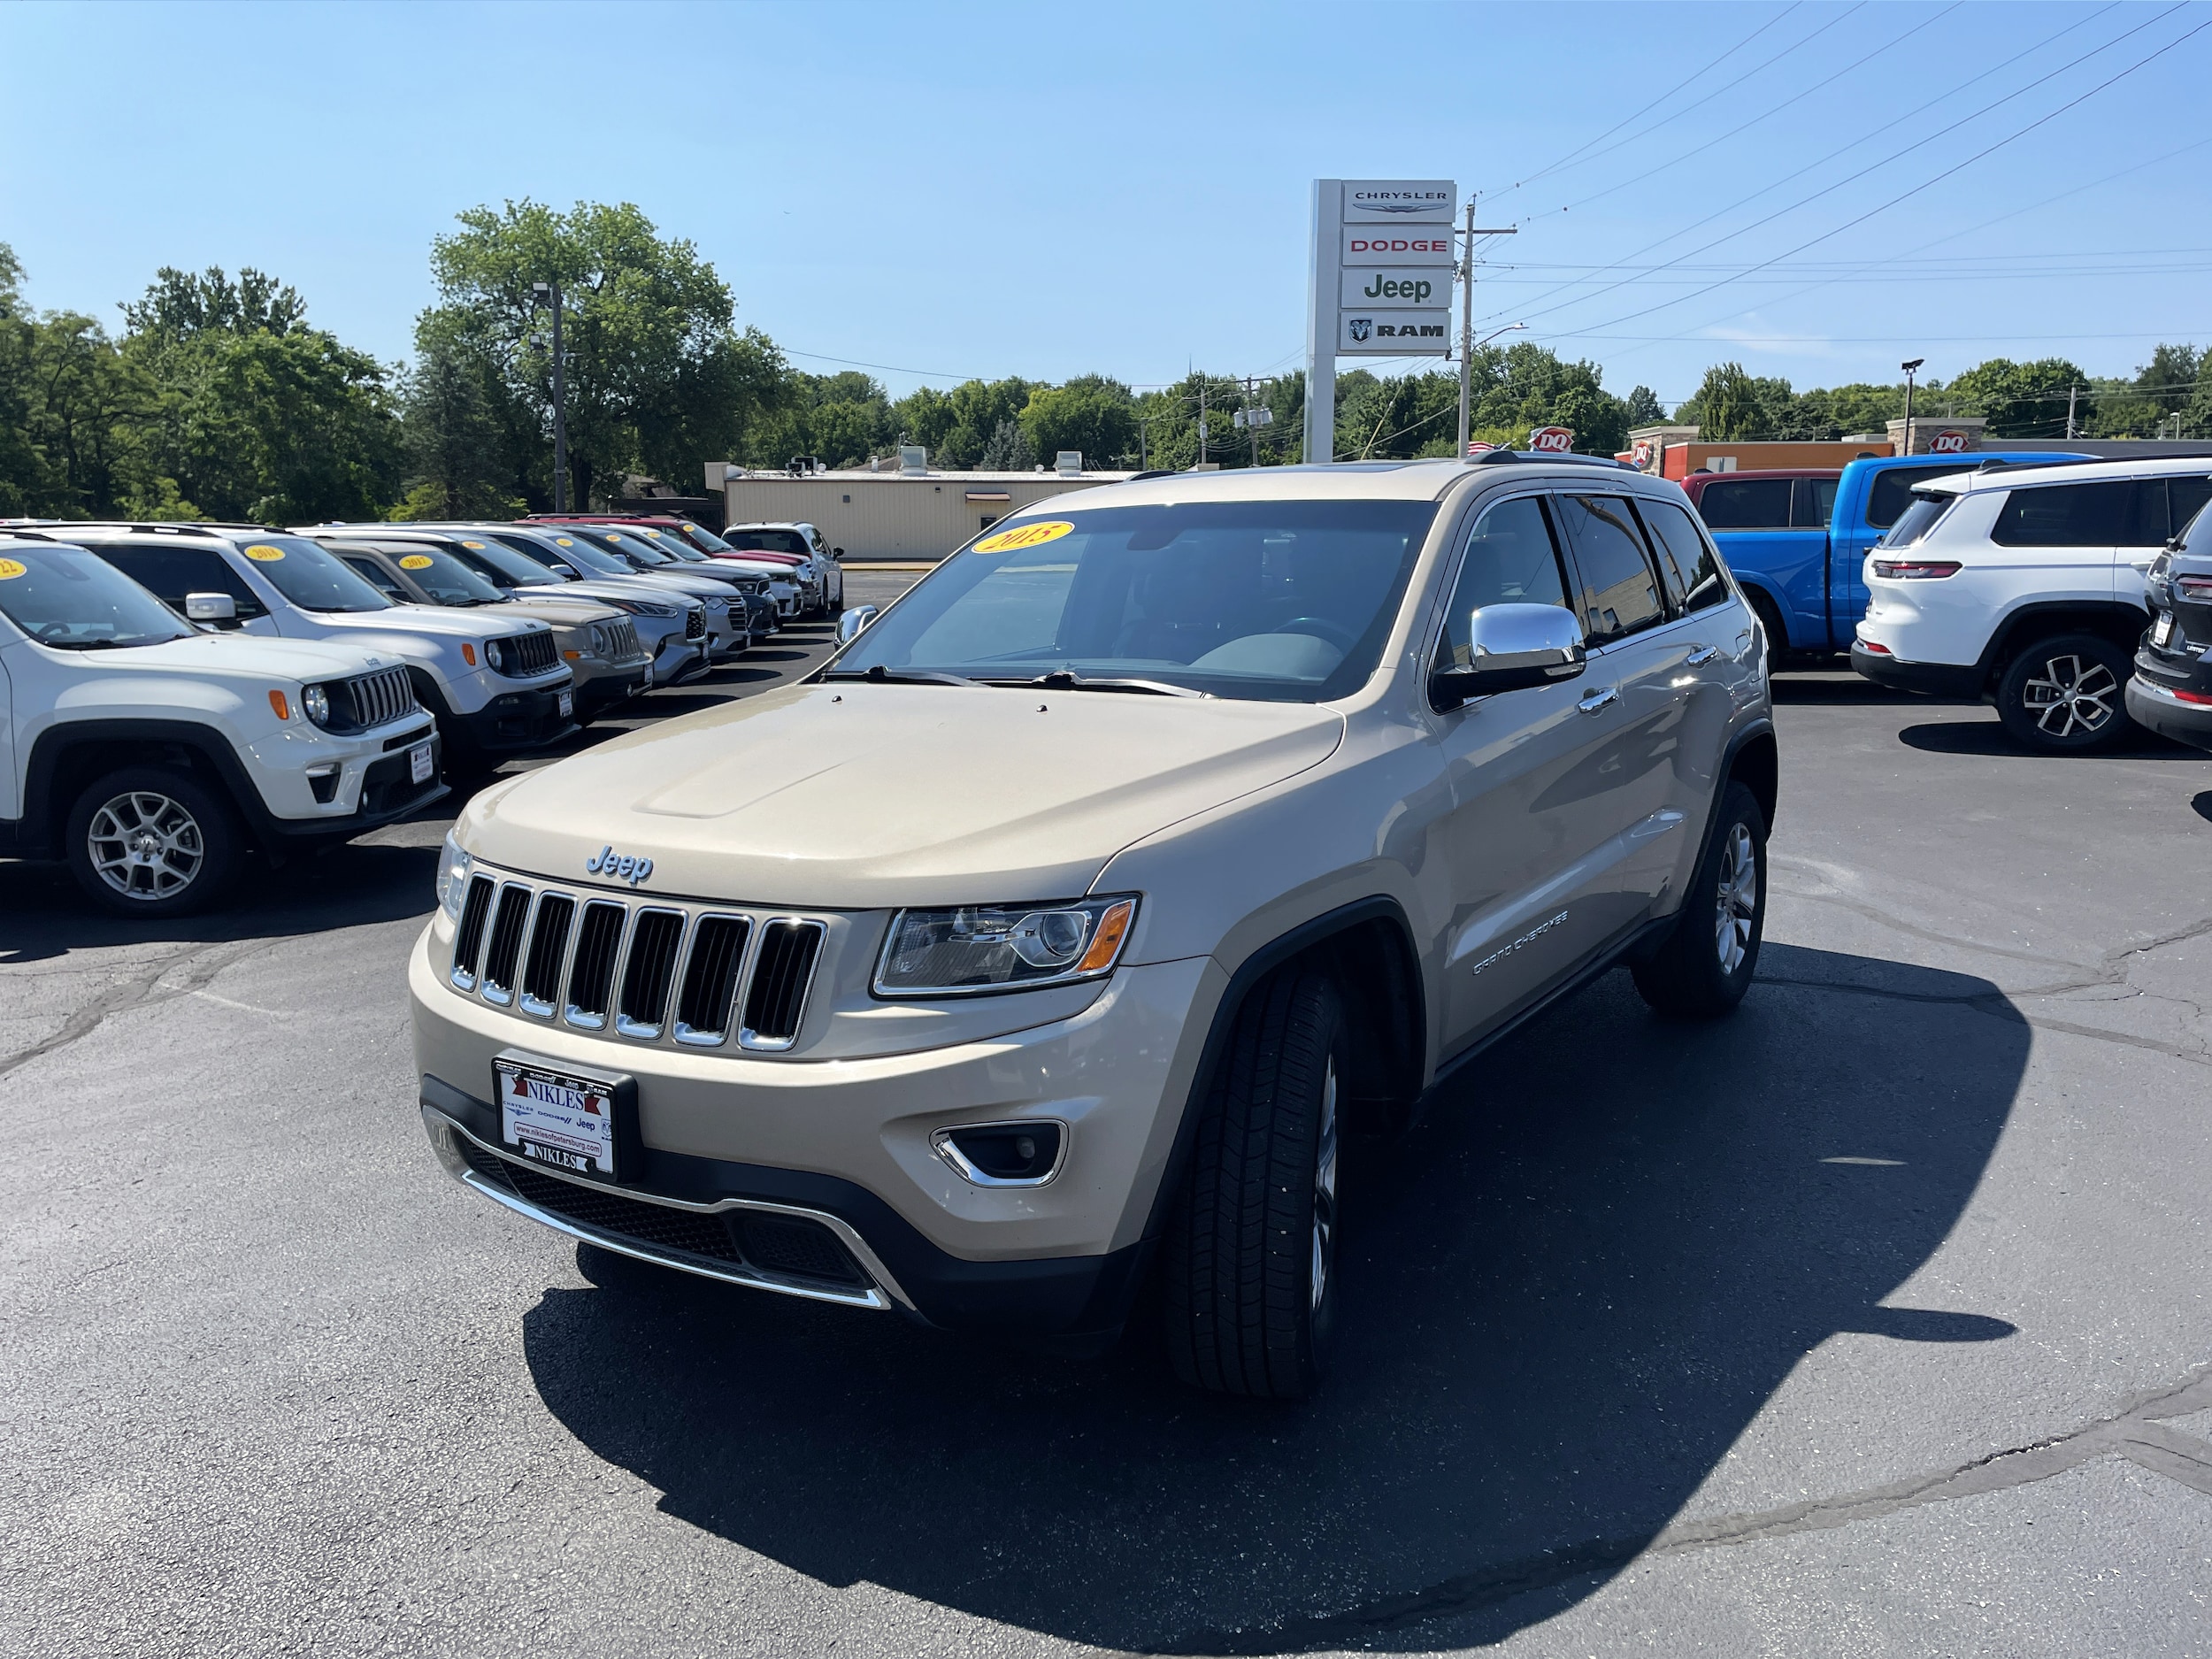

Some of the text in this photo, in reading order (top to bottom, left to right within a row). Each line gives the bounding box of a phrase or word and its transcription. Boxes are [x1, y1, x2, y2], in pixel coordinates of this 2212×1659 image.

[1351, 240, 1448, 252] DODGE
[1364, 273, 1432, 303] Jeep
[1377, 325, 1444, 337] RAM
[1538, 434, 1567, 449] DQ
[1636, 446, 1647, 461] DQ
[1936, 436, 1964, 452] DQ
[982, 525, 1062, 550] 2015
[405, 557, 426, 568] 2017
[586, 844, 653, 887] Jeep
[1472, 910, 1569, 975] GRAND CHEROKEE
[528, 1080, 585, 1111] NIKLES
[565, 1079, 580, 1090] Jeep
[503, 1101, 534, 1111] CHRYSLER
[576, 1118, 595, 1132] Jeep
[516, 1125, 601, 1154] www.niklesofpetersburg.com
[534, 1145, 577, 1170] NIKLES
